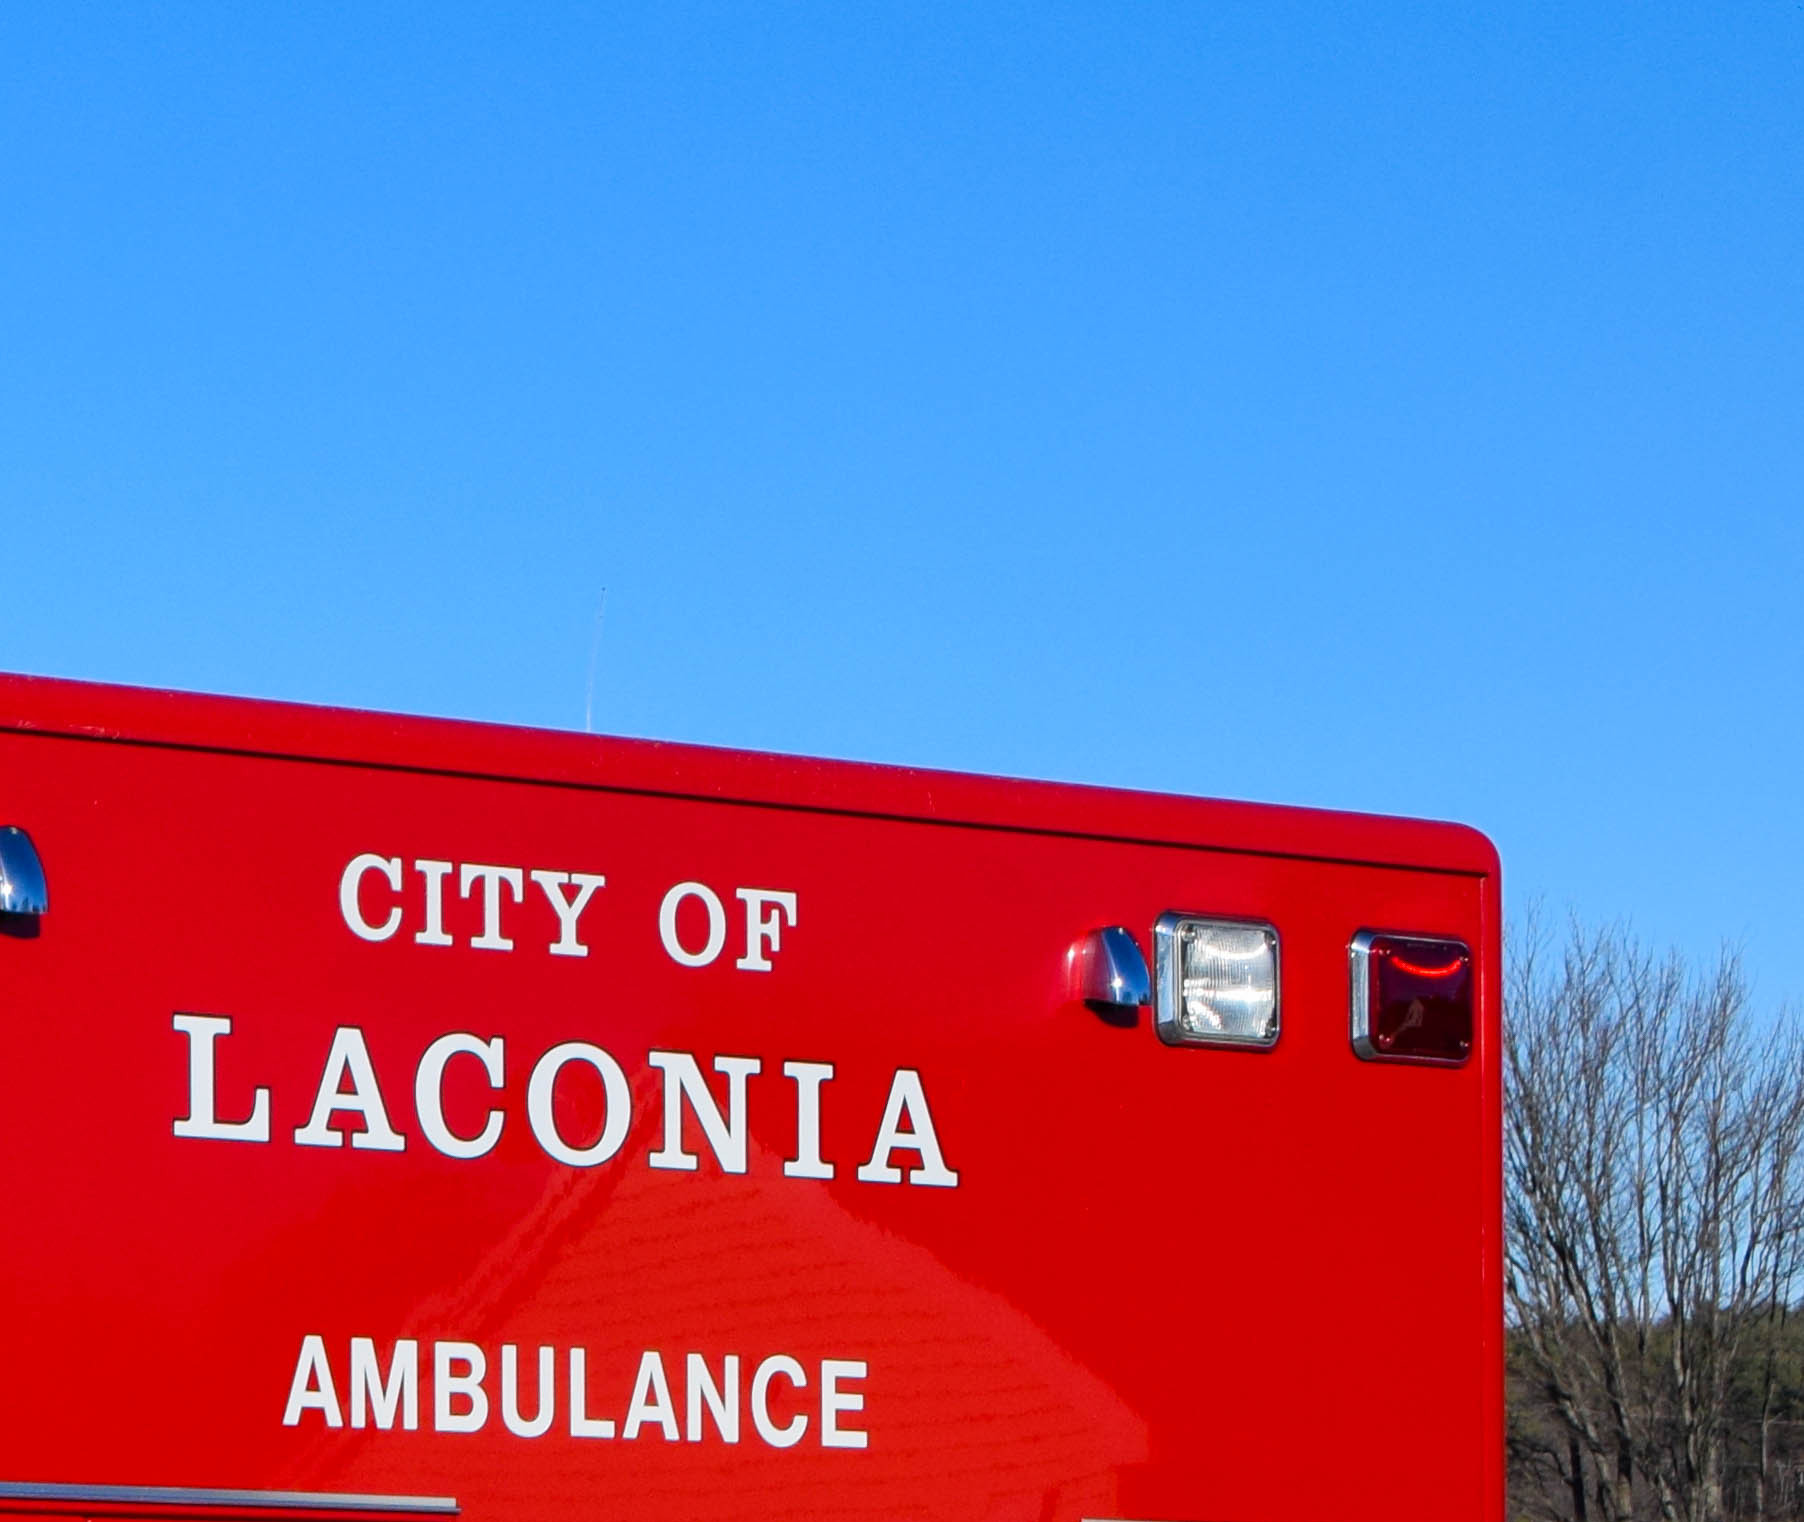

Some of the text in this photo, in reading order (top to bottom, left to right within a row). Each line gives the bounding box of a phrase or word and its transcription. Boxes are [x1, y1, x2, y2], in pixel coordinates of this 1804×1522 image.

[339, 853, 798, 972] CITY OF
[172, 1013, 959, 1189] LACONIA
[282, 1334, 869, 1449] AMBULANCE
